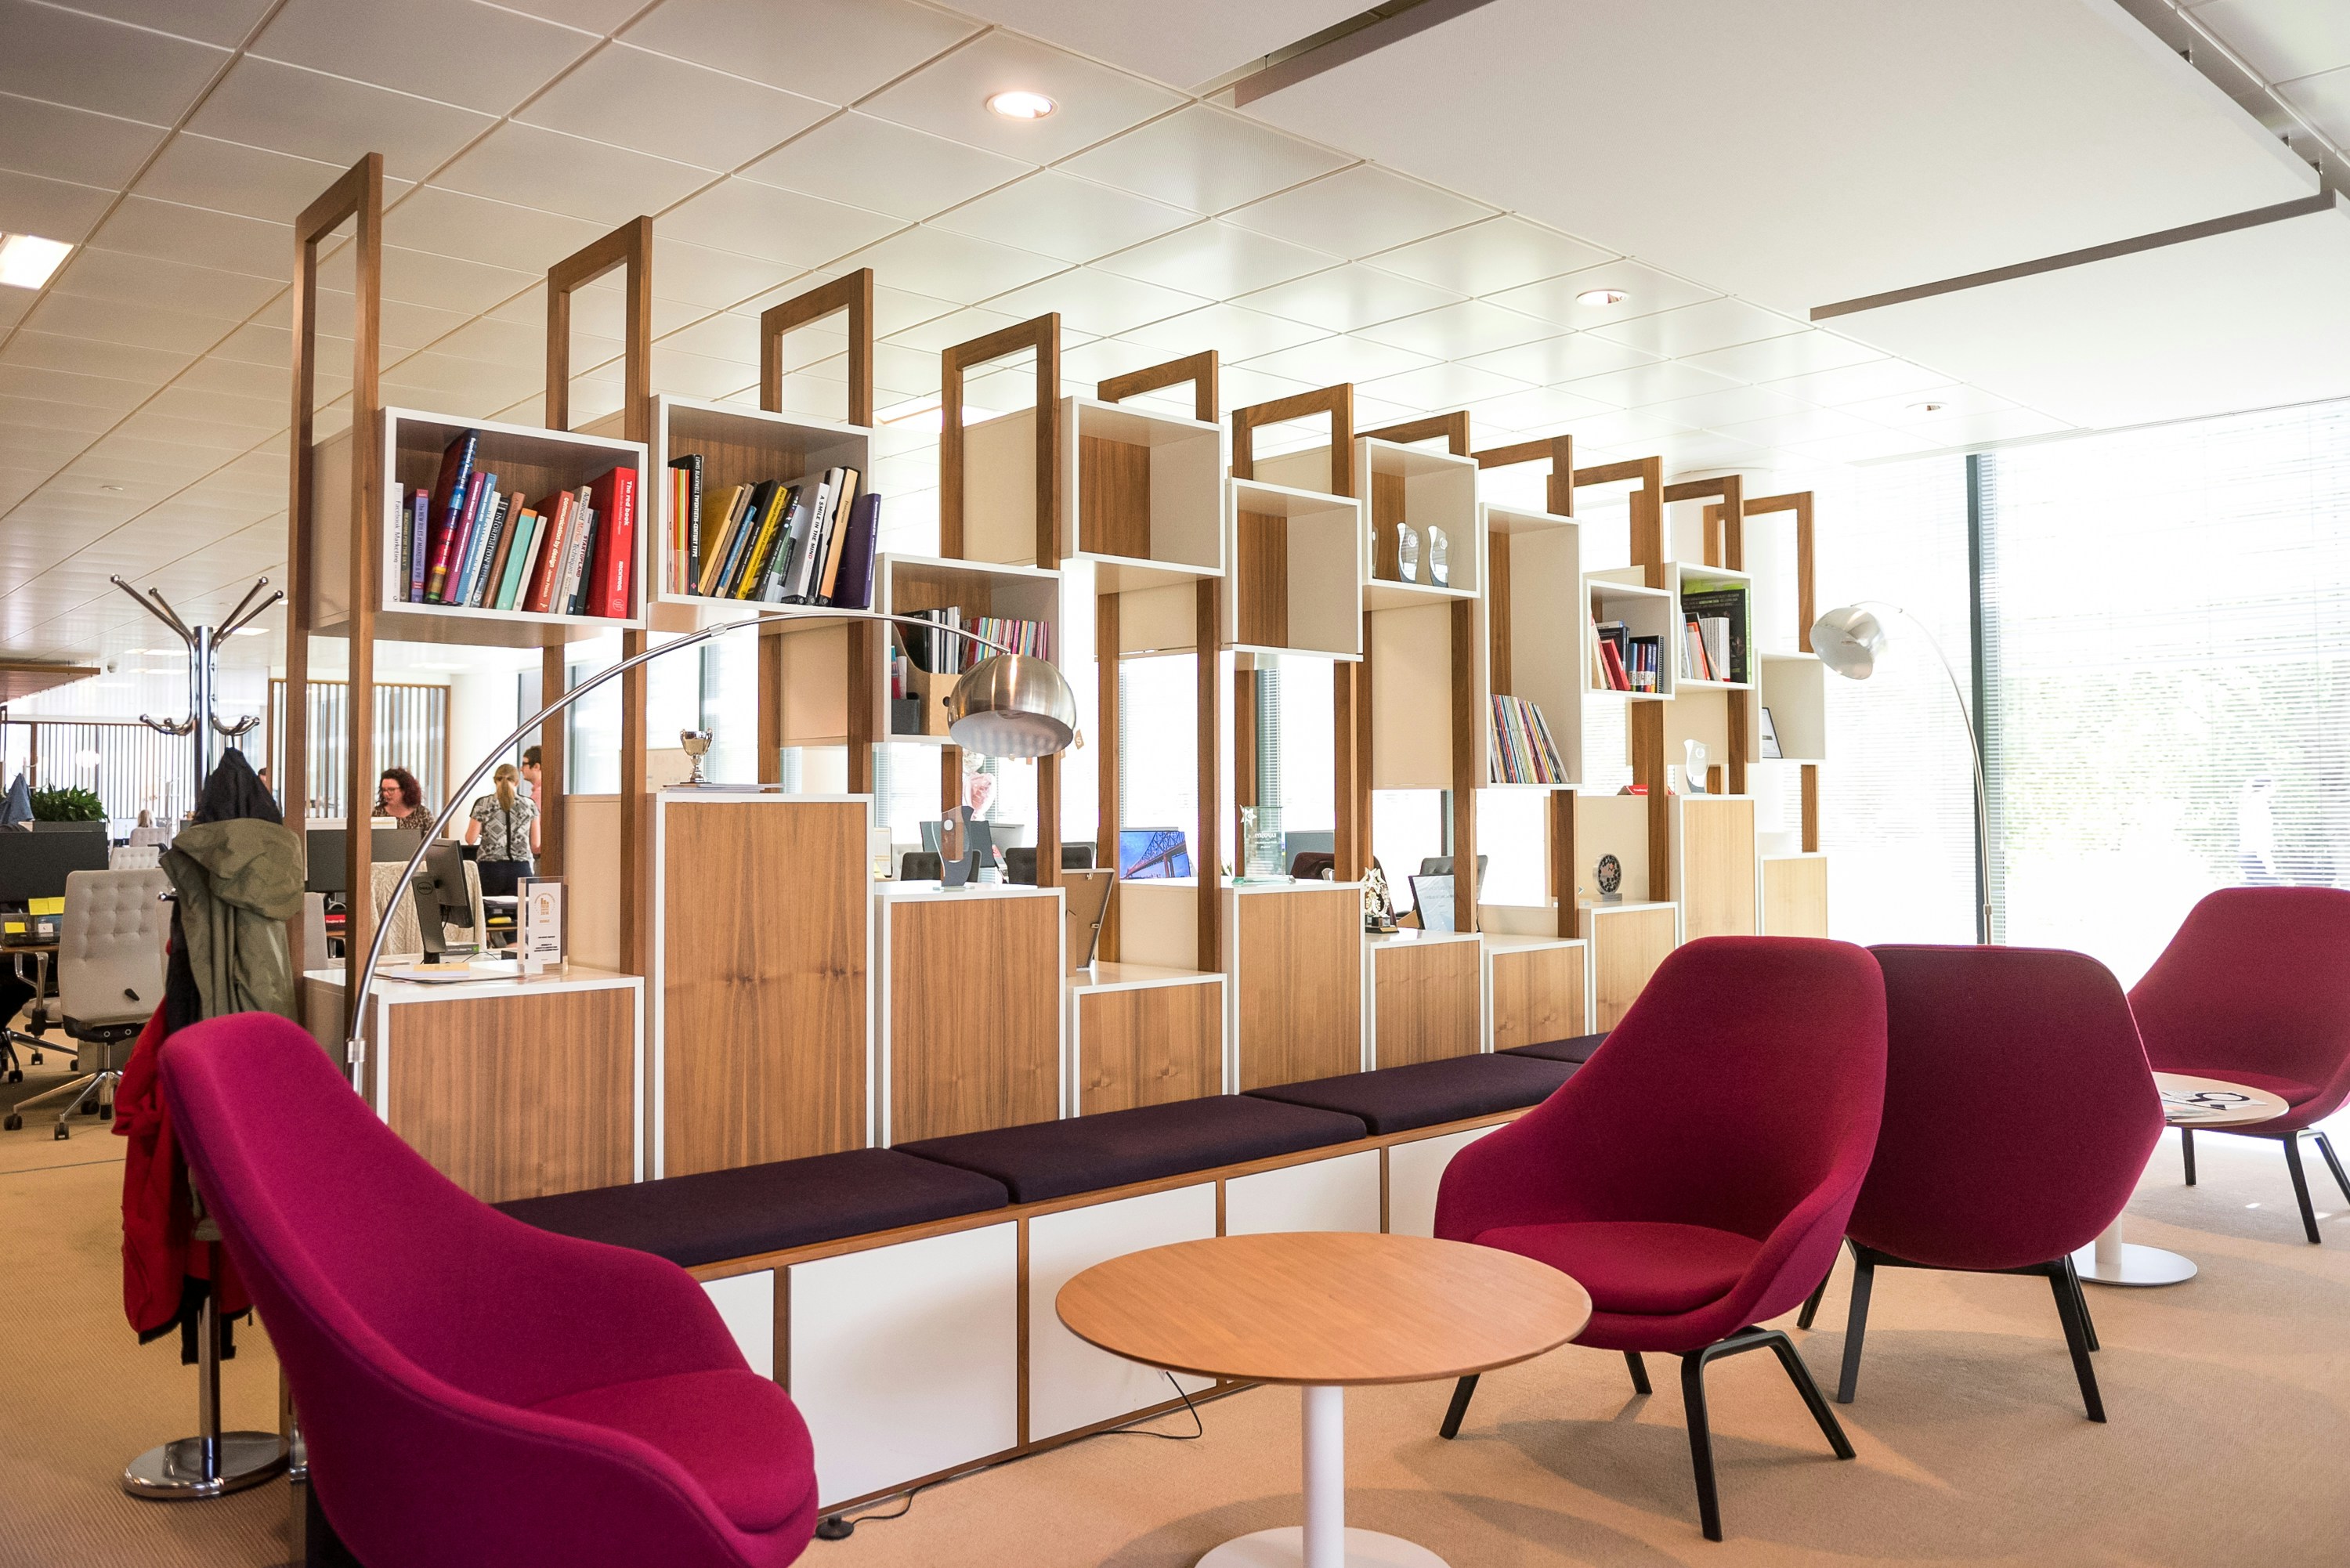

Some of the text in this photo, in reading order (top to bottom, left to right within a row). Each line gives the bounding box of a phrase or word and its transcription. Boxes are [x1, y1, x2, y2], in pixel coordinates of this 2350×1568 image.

[555, 497, 570, 540] communication
[839, 500, 849, 524] Pentagram
[552, 540, 561, 548] by
[566, 491, 589, 575] Advanced Marker Techniques
[548, 547, 559, 568] design
[574, 534, 588, 577] STARTUPLAND
